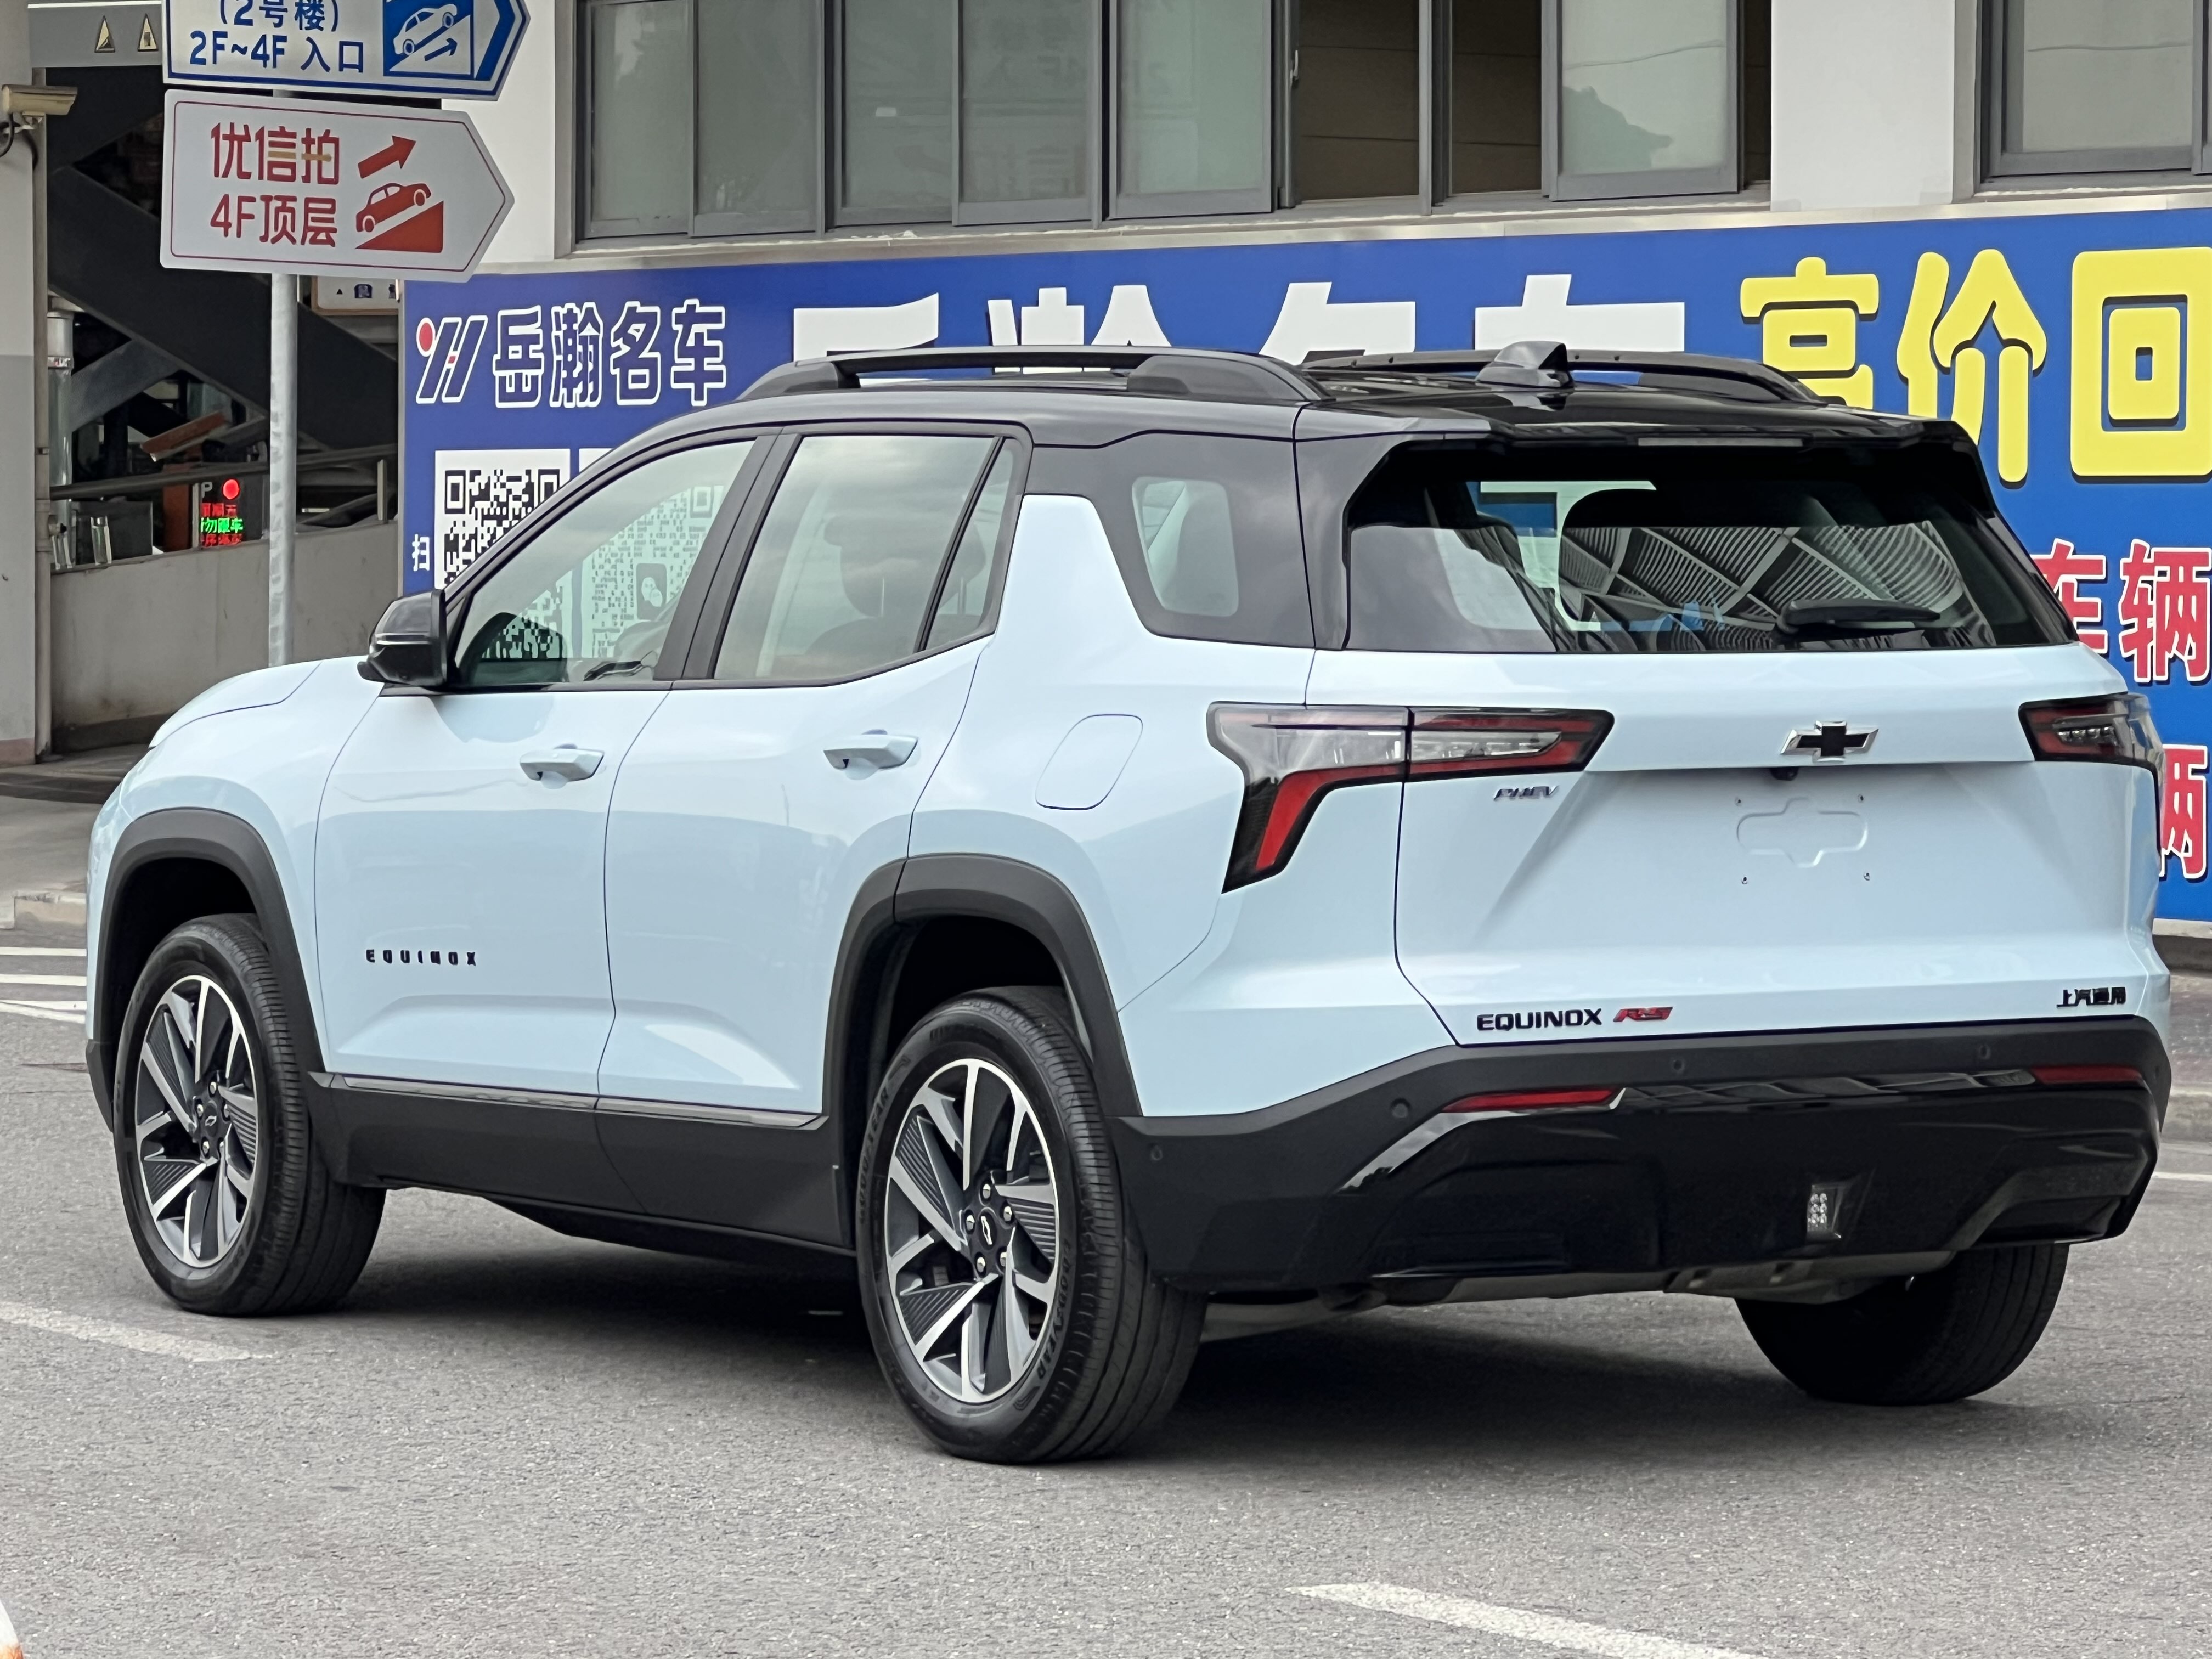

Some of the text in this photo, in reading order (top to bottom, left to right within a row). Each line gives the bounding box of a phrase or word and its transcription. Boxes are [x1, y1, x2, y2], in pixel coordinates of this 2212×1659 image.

[220, 0, 338, 32] (2号楼)
[190, 30, 364, 73] 2F~4F 入口
[211, 122, 340, 185] 优信拍
[210, 194, 338, 247] 4F顶层
[493, 298, 727, 408] 岳瀚名车
[411, 533, 430, 572] 扫
[2030, 538, 2212, 682] 车辆
[1493, 785, 1559, 802] PHEV
[365, 949, 477, 966] EQUINOX
[1476, 1006, 1674, 1031] EQUINOX RS
